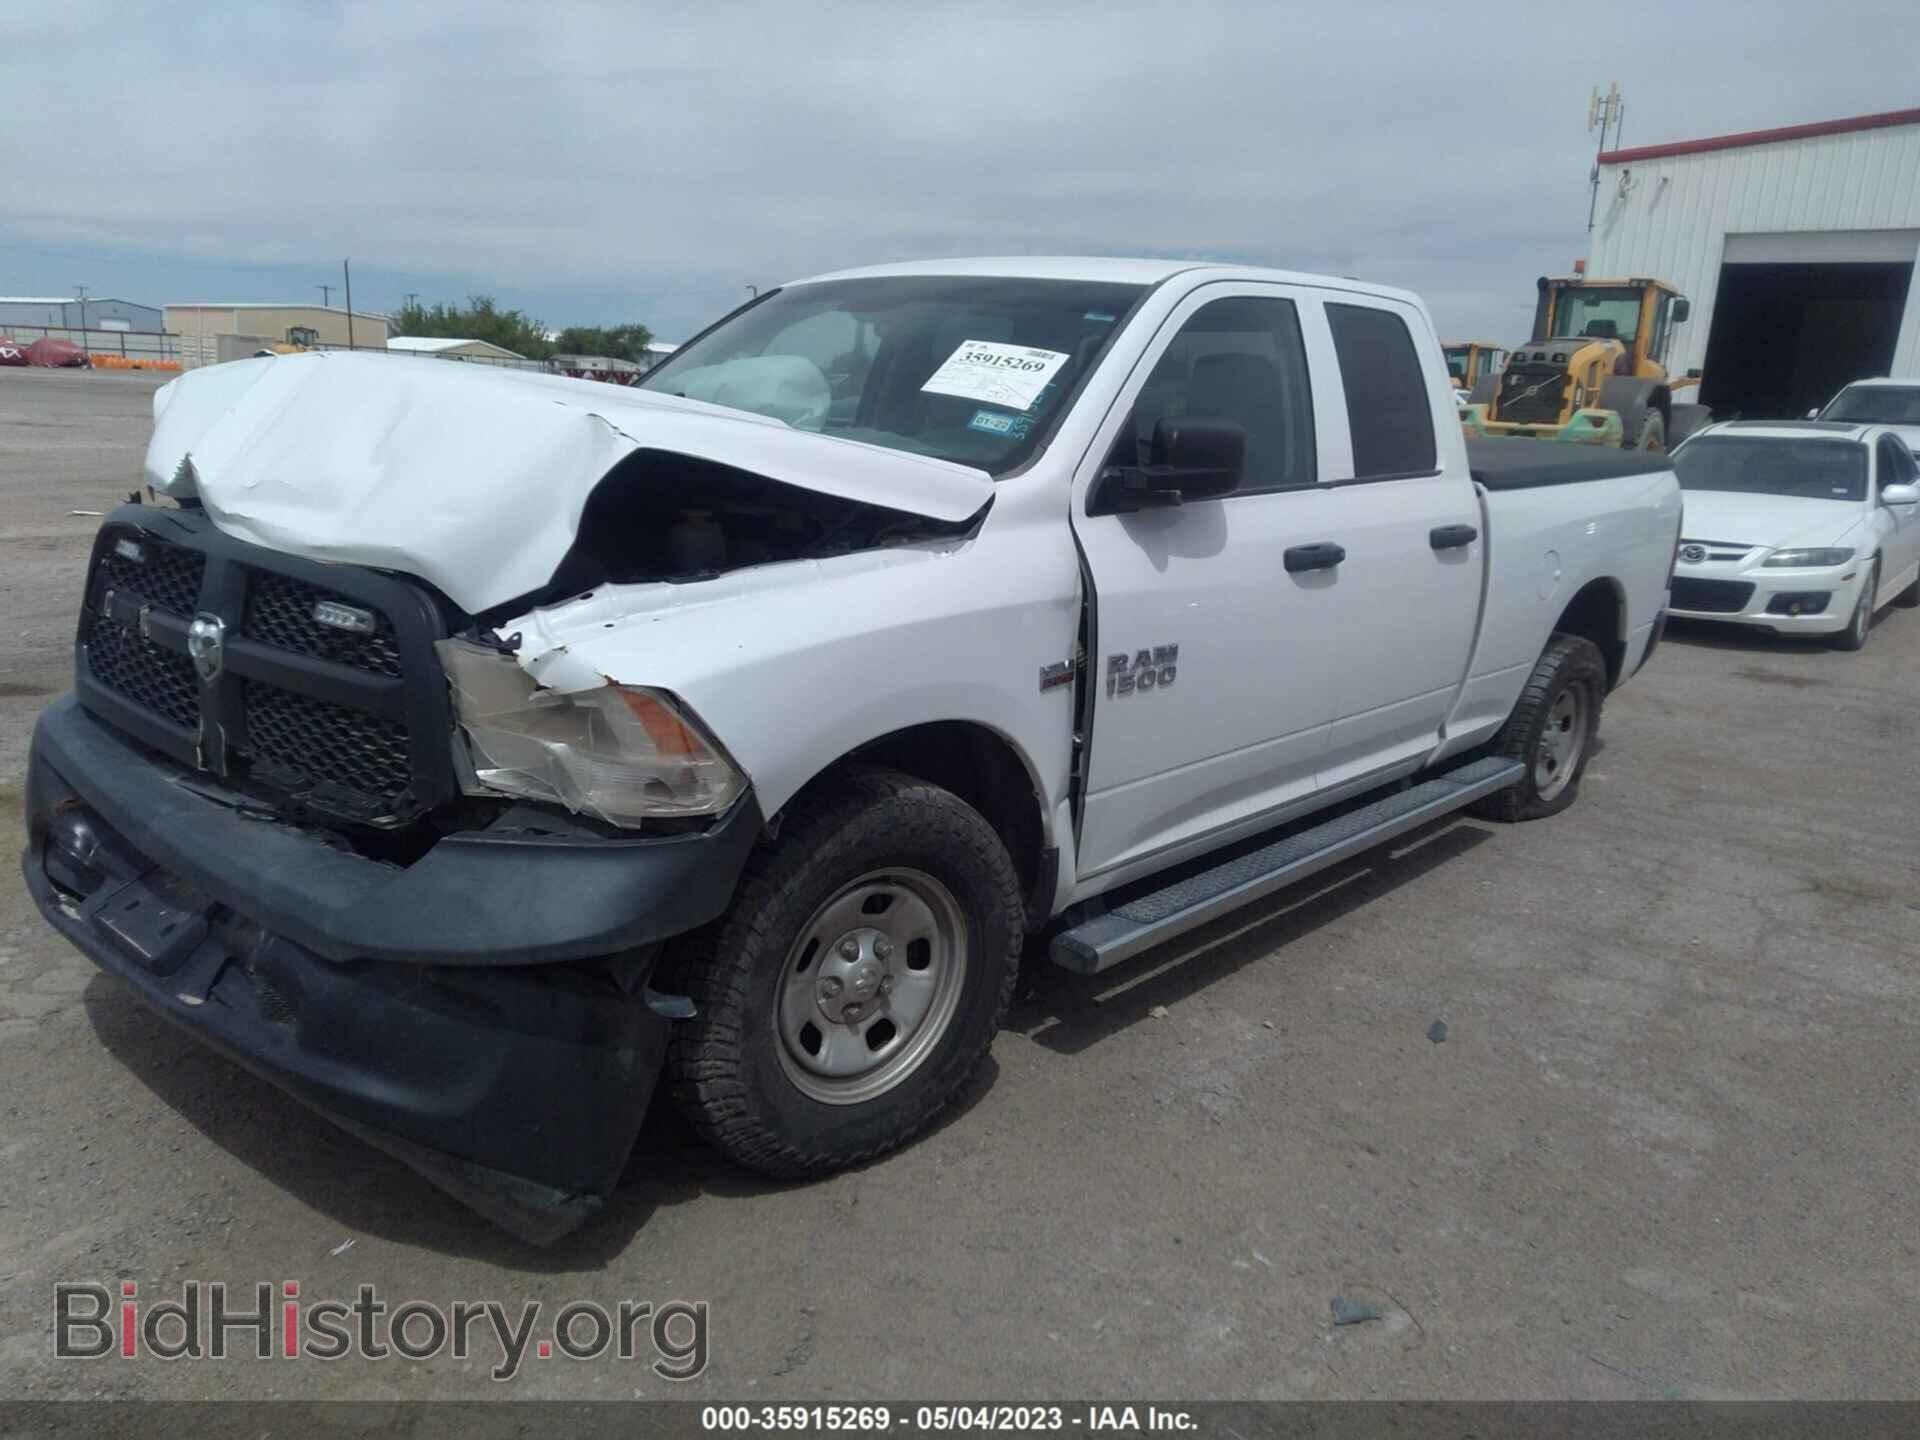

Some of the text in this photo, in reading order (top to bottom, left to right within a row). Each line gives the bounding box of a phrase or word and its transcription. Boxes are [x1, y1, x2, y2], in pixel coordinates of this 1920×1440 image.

[958, 351, 1046, 372] 35915269
[1107, 644, 1178, 674] RAM
[1106, 666, 1176, 700] 1500
